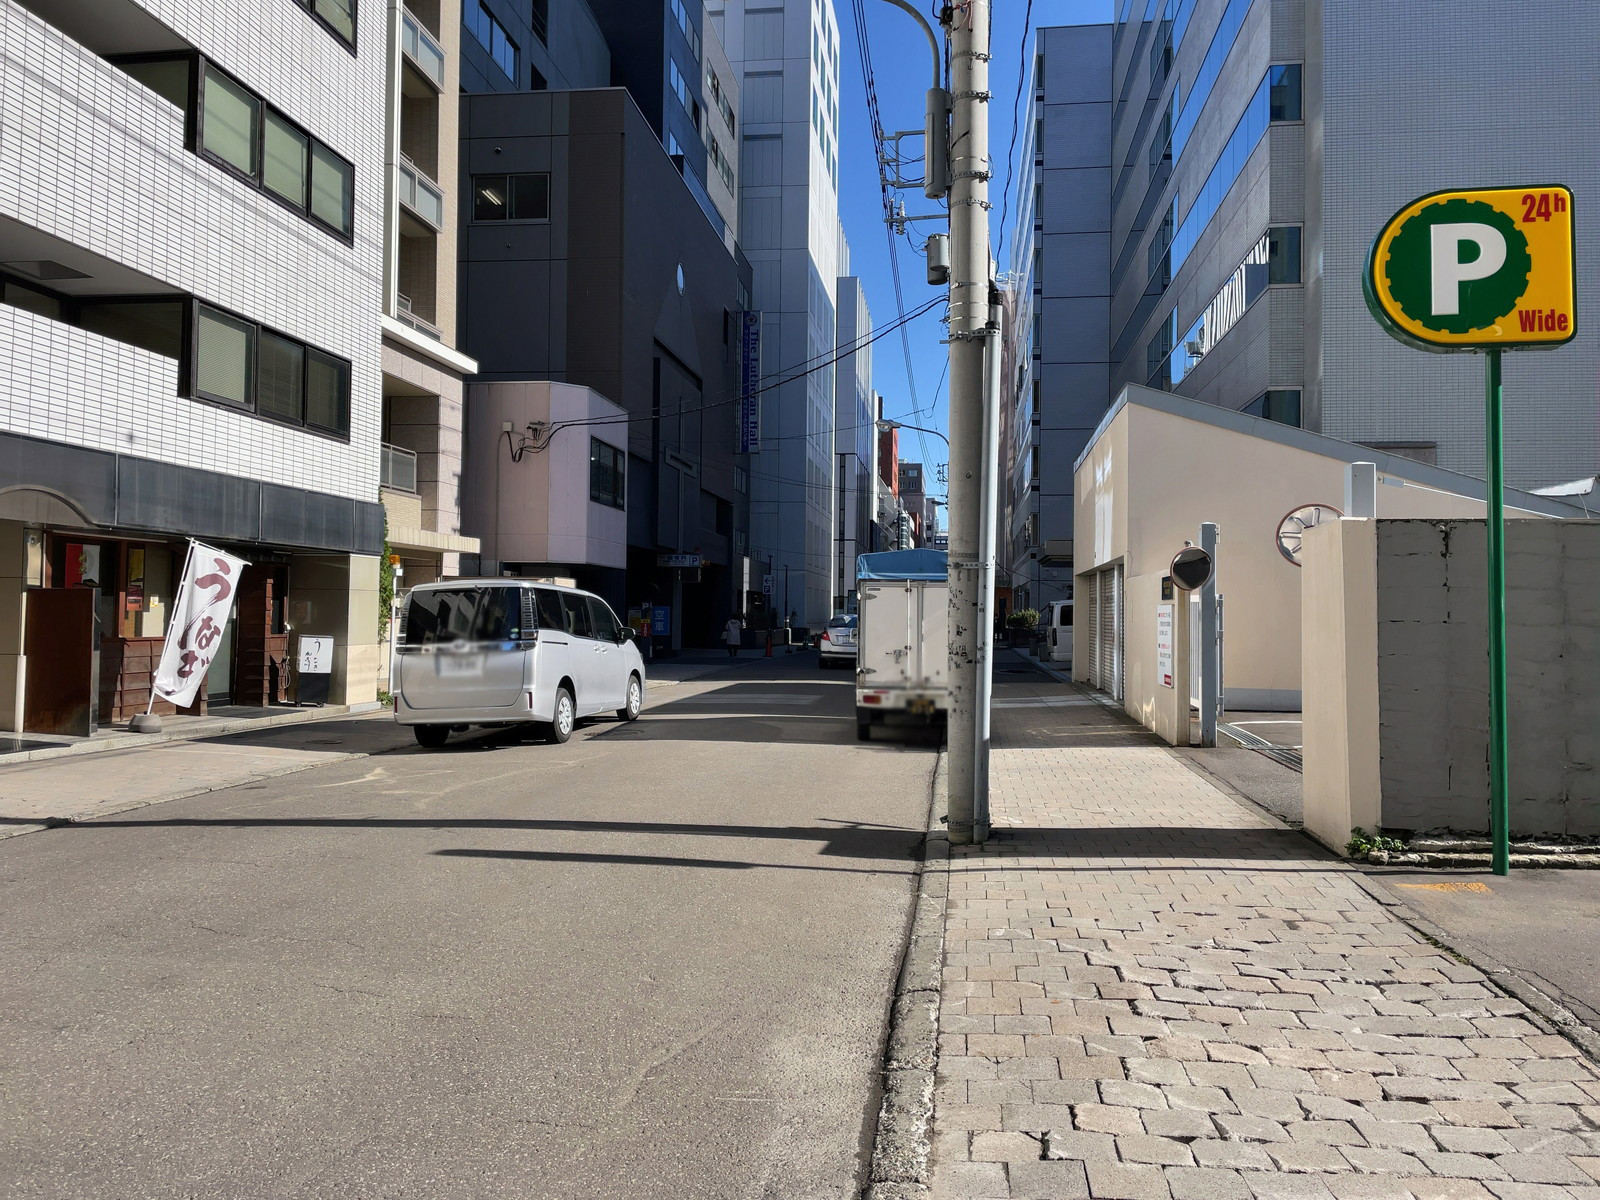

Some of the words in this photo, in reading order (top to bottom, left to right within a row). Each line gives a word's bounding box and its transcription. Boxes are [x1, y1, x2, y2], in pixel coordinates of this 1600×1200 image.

[1521, 193, 1566, 223] 24h
[1430, 222, 1507, 316] P
[1518, 309, 1569, 332] Wide
[750, 330, 759, 354] The
[750, 359, 759, 416] Lutheran
[749, 421, 758, 446] Hall
[692, 557, 698, 565] P
[168, 557, 232, 695] うなぎ
[654, 609, 665, 632] 空車
